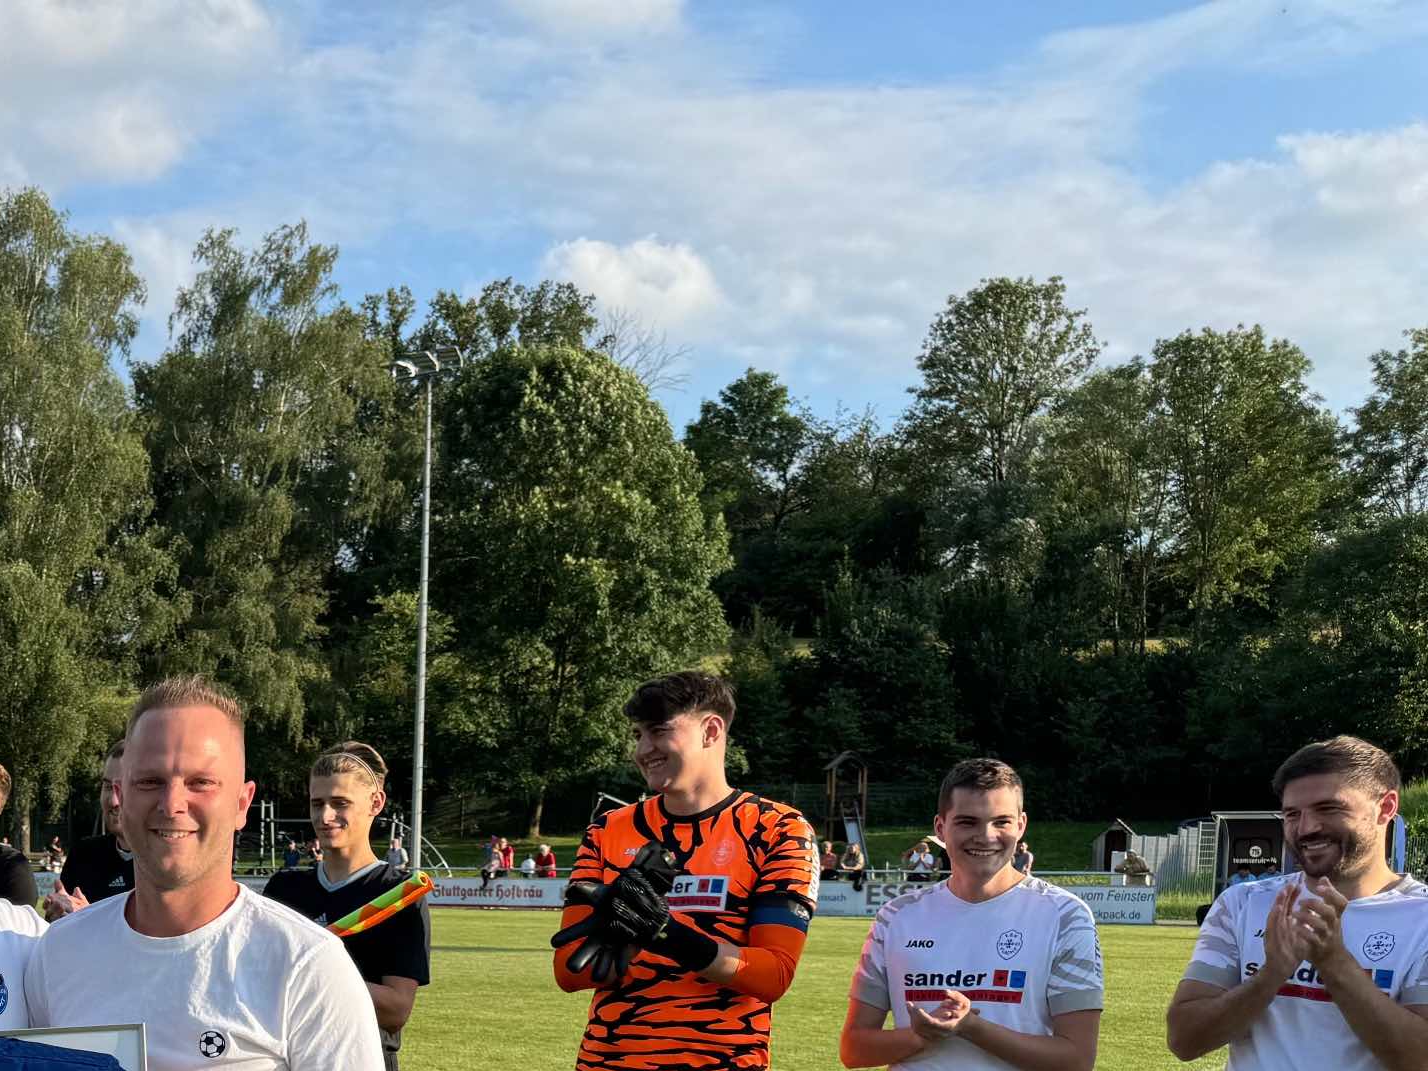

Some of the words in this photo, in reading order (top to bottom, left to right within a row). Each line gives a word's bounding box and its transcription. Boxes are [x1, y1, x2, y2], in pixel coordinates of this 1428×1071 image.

[432, 884, 493, 901] Stuttgarter
[495, 884, 543, 900] Hofbräu
[1081, 890, 1104, 901] vom
[1106, 889, 1154, 902] Feinsten
[905, 940, 934, 949] JAKO
[904, 970, 987, 988] sander
